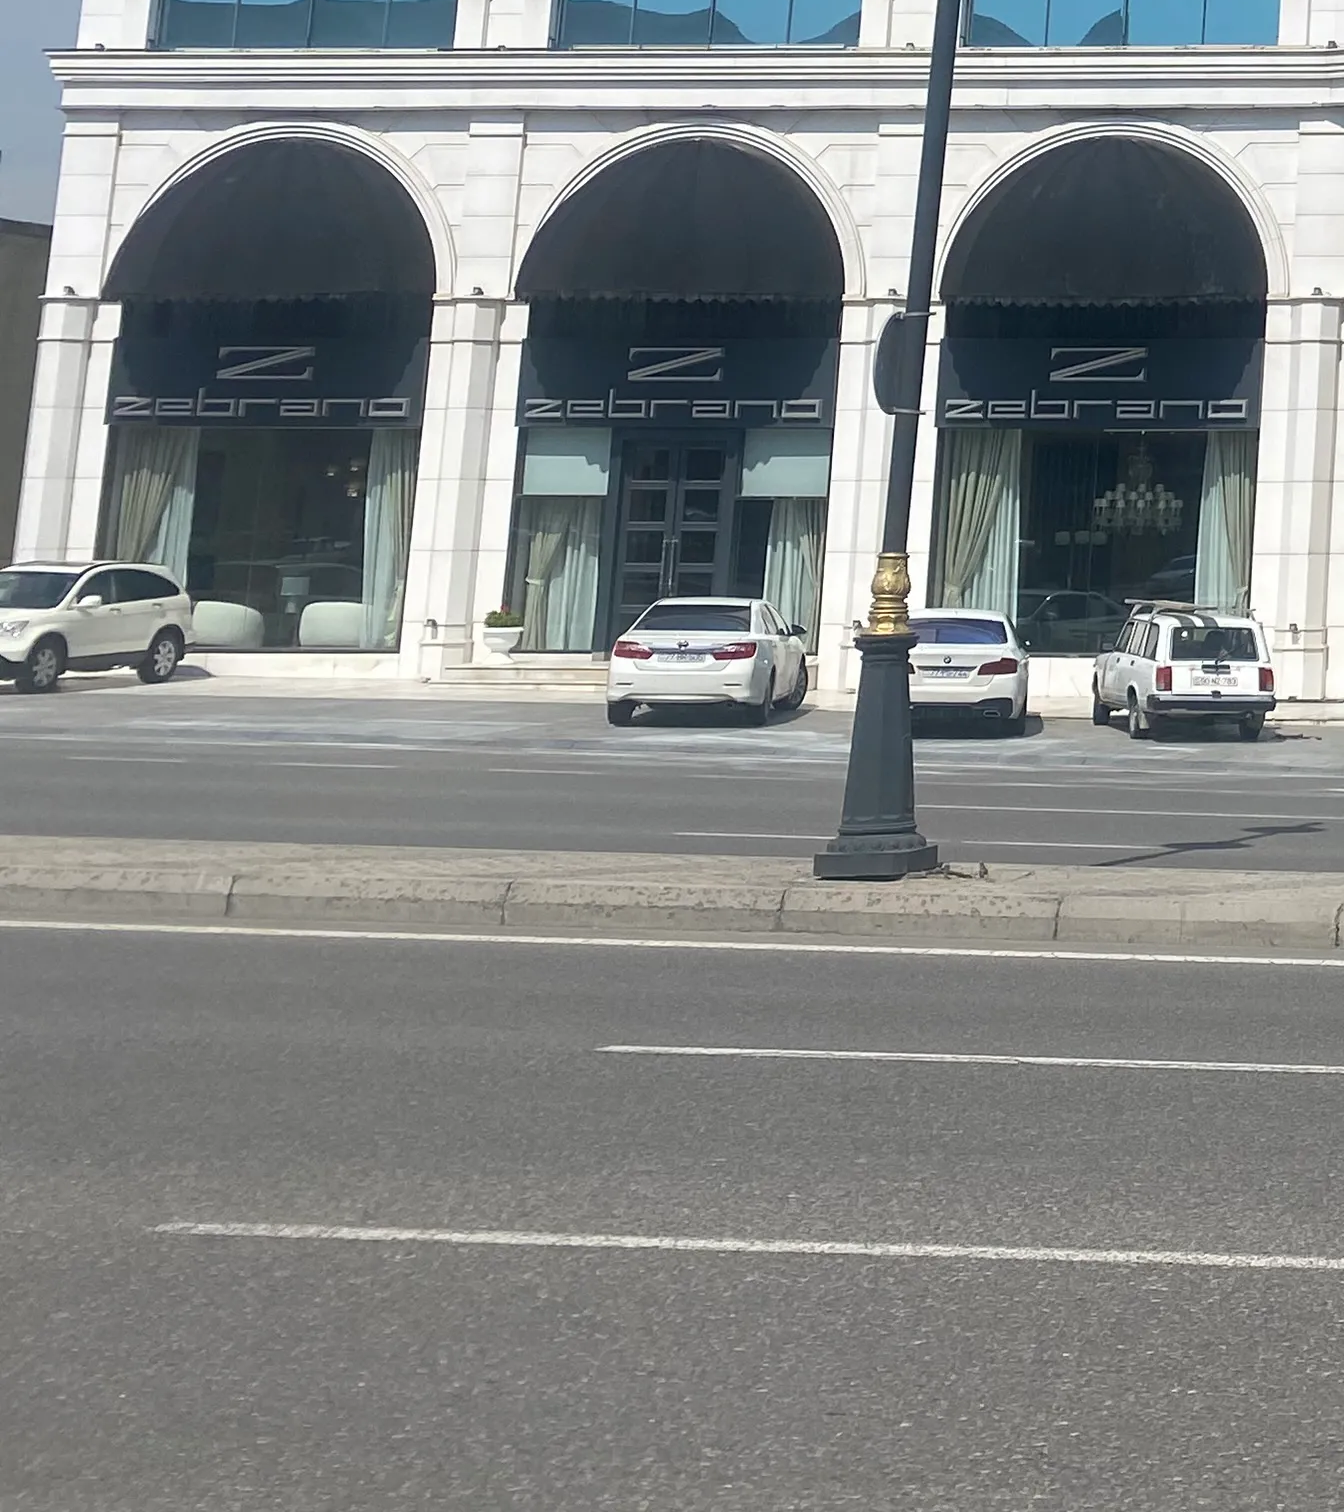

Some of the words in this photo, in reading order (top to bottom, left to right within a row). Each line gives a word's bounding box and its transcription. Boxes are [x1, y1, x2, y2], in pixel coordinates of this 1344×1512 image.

[112, 387, 411, 417] zebrano
[524, 388, 823, 419] zebrano
[945, 389, 1248, 419] zebrano
